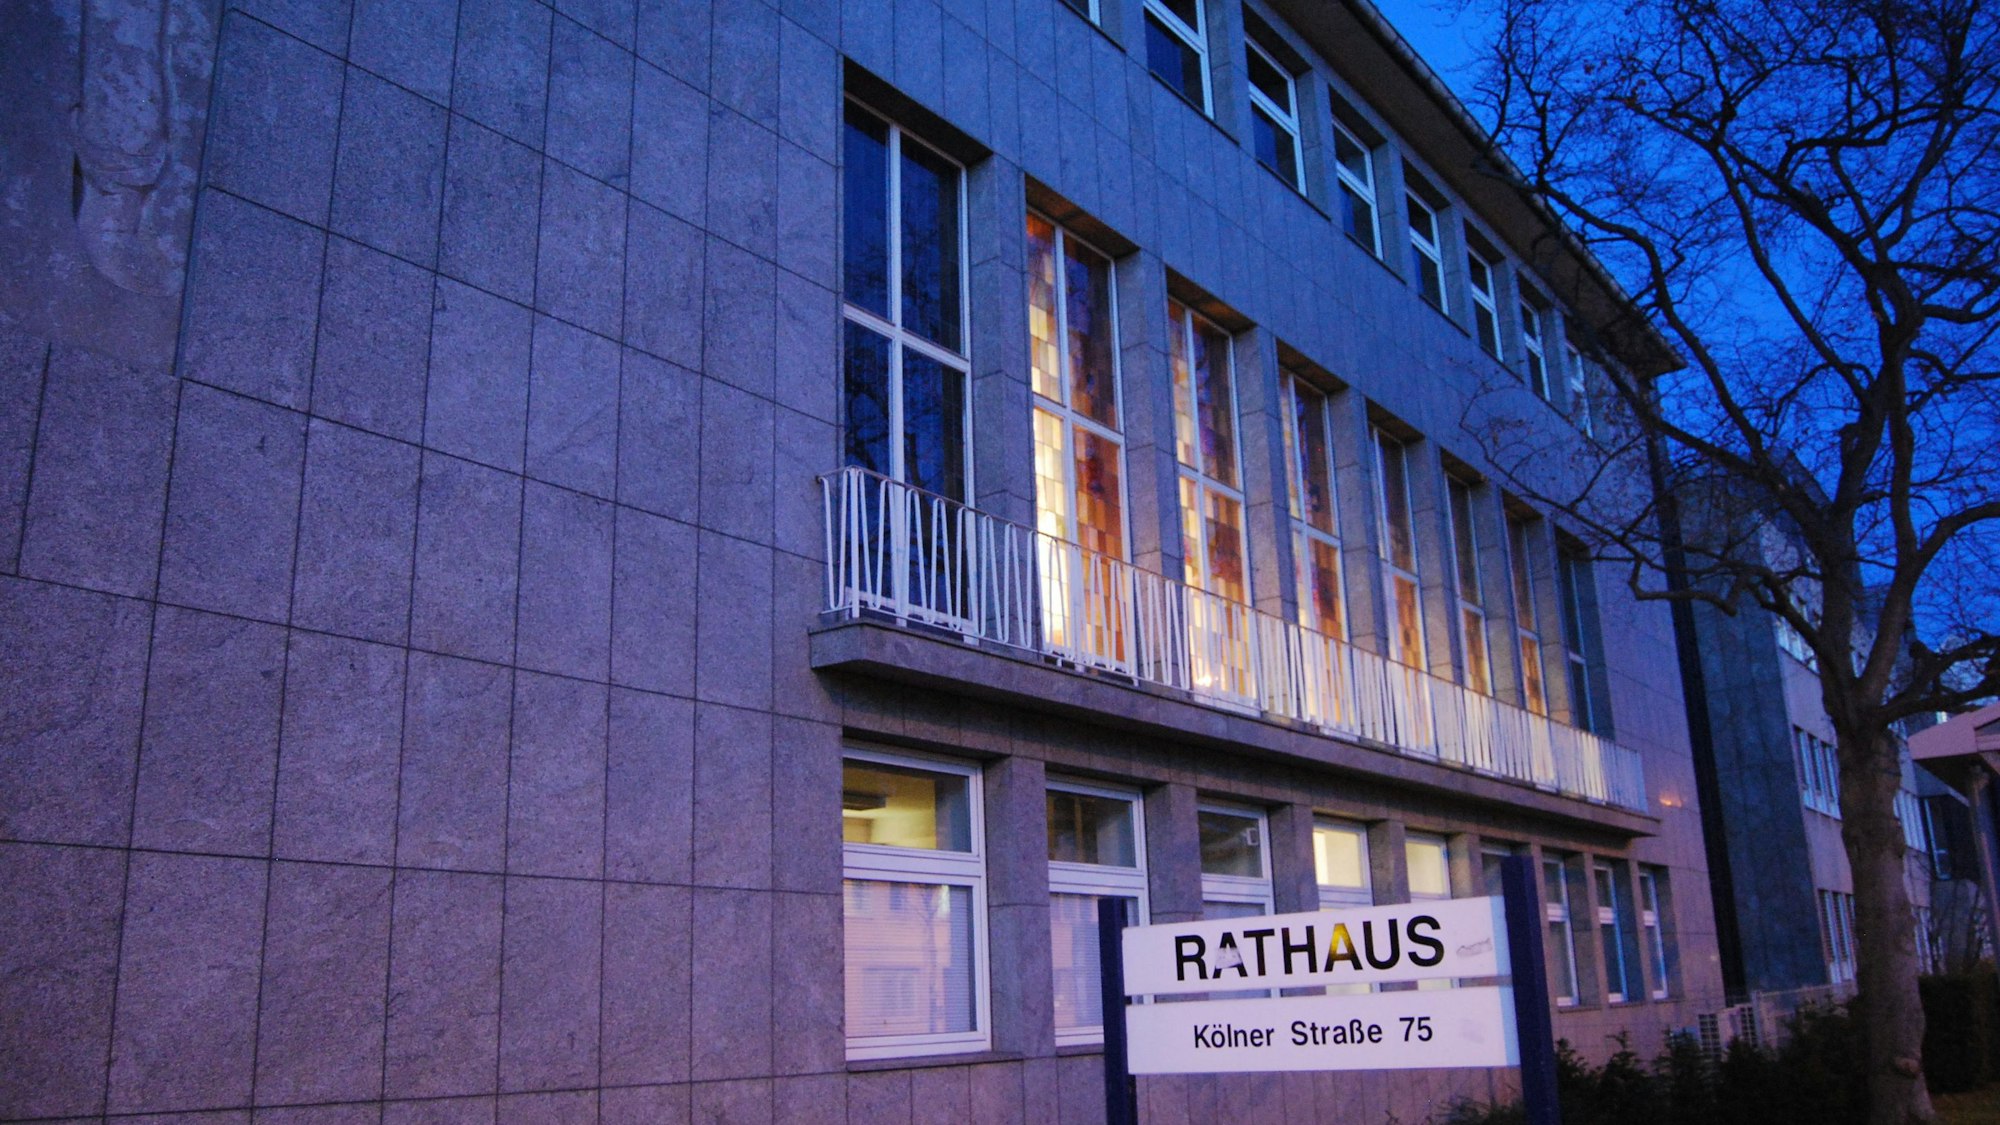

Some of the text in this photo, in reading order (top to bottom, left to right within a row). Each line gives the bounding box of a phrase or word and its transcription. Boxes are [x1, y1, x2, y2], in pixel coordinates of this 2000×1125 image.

[1174, 915, 1445, 981] RATHAUS
[1194, 1016, 1433, 1049] Kölner Straße 75
